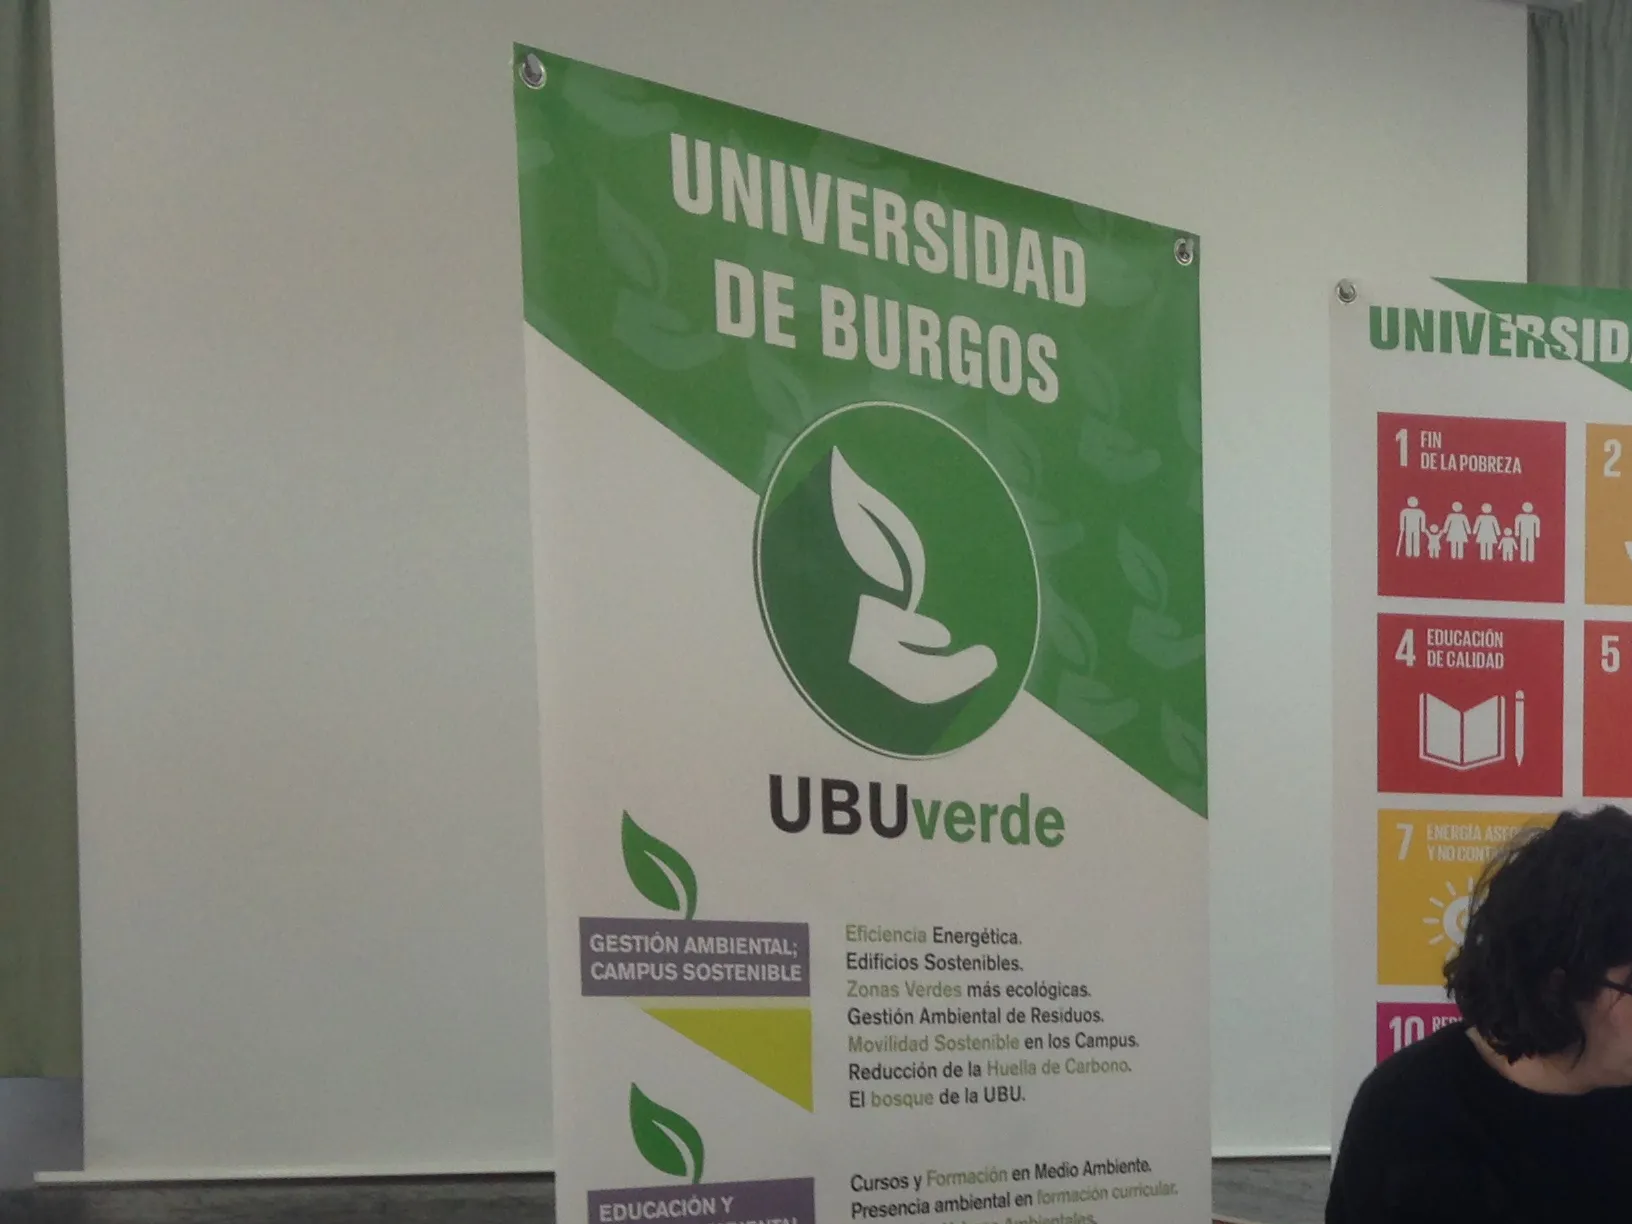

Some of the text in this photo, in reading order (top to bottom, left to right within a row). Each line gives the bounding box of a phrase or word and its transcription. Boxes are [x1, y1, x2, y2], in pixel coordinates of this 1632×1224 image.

[669, 132, 1087, 308] UNIVERSIDAD
[714, 258, 1059, 404] DE BURGOS
[1396, 429, 1442, 466] 1 FIN
[1604, 439, 1622, 478] 2
[1421, 452, 1522, 474] DE LA POBREZA
[1396, 628, 1504, 666] 4 EDUCACIÓN
[1428, 651, 1504, 669] DE CALIDAD
[1601, 635, 1620, 672] 5
[769, 774, 1066, 847] UBUverde
[590, 931, 678, 954] GESTIÓN
[846, 925, 1022, 947] Eficiencia Energética.
[591, 962, 801, 982] CAMPUS SOSTENIBLE
[846, 952, 1023, 971] Edificios Sostenibles.
[847, 981, 1091, 1001] Zonas Verdes más ecológicas.
[848, 1007, 1104, 1026] Gestión Ambiental de Residuos.
[849, 1032, 1139, 1052] Movilidad Sostenible en los Campus.
[1389, 1016, 1424, 1053] 10
[849, 1058, 1132, 1080] Reducción de la Huella de Carbono.
[850, 1086, 1025, 1109] El bosque de la UBU.
[851, 1158, 1151, 1192] Cursos y Formación en Medio Ambiente.
[600, 1194, 734, 1223] EDUCACIÓN Y
[852, 1181, 1178, 1219] Presencia ambiental en formación curricular.
